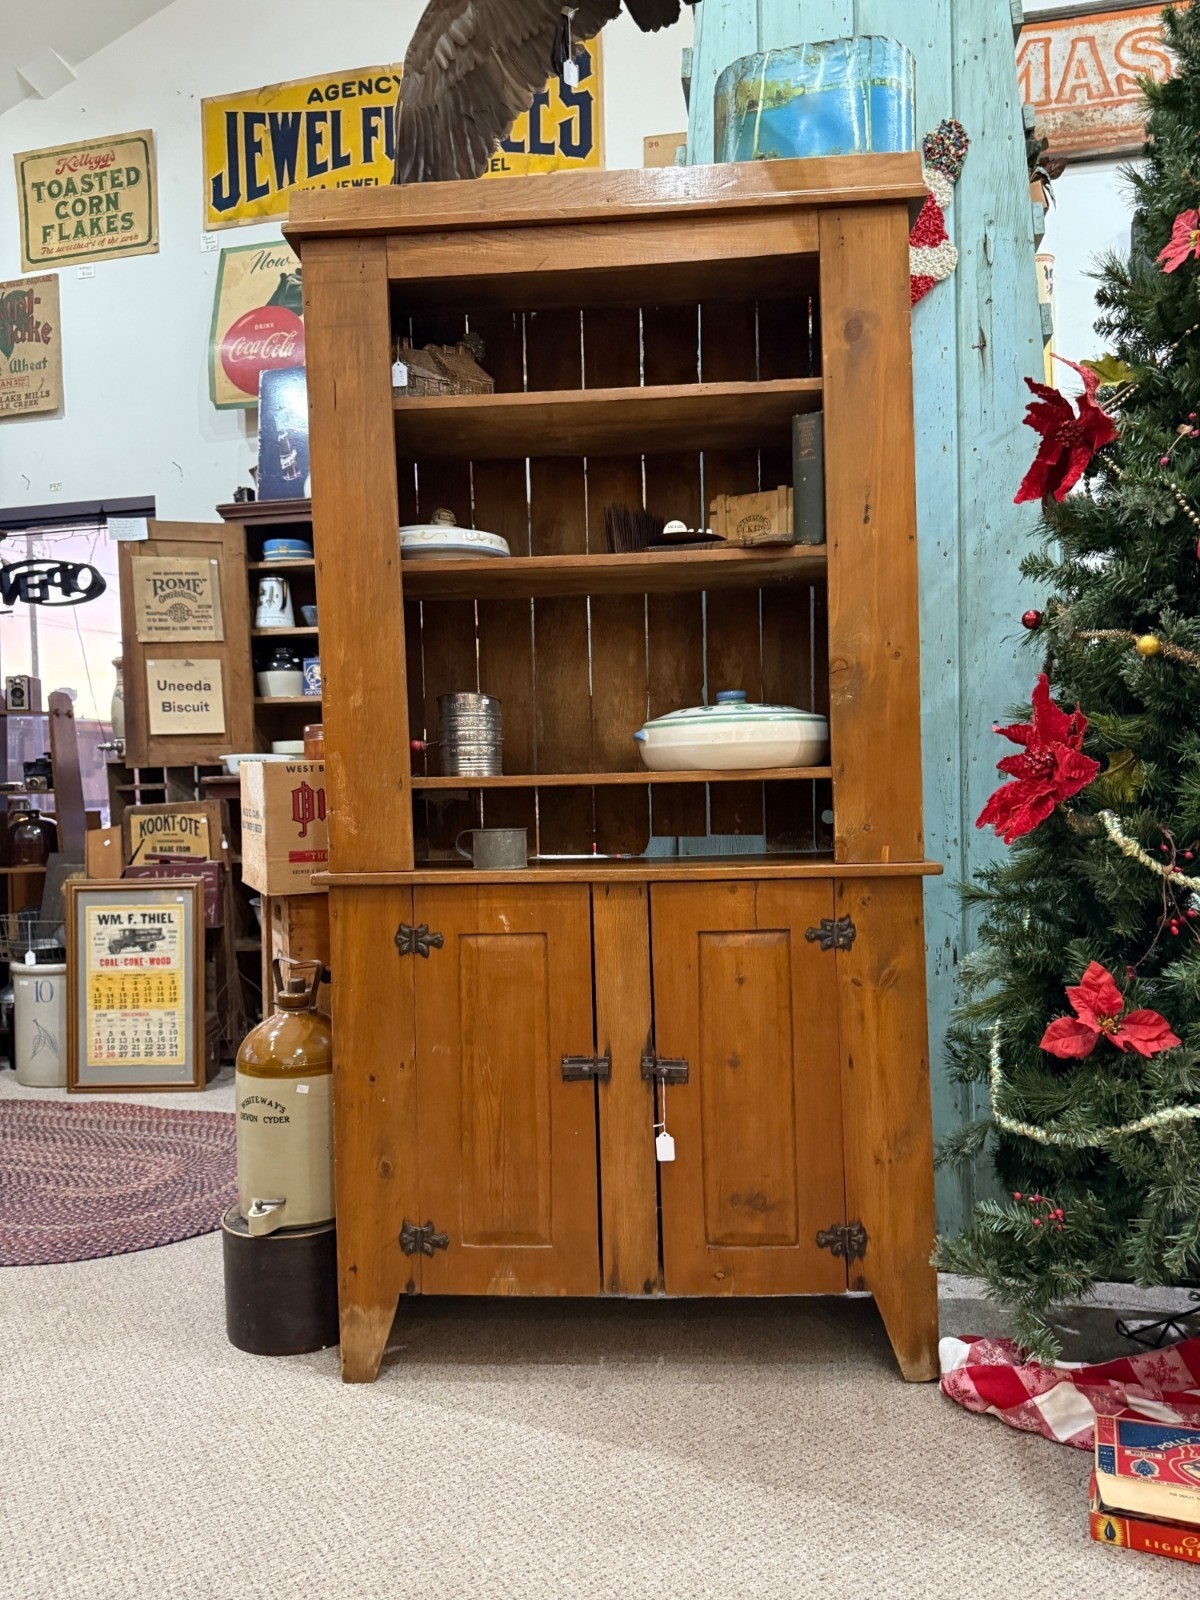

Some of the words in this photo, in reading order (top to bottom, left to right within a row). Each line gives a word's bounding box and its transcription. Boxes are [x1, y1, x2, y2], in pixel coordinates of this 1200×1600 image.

[211, 110, 351, 213] JEWEL
[31, 166, 142, 203] TOASTED
[55, 191, 121, 220] CORN
[42, 212, 135, 245] FLAKES
[255, 322, 274, 331] DRINK
[24, 390, 51, 401] MILLS
[13, 399, 39, 408] CREEK
[157, 680, 212, 691] Uneeda
[162, 701, 210, 713] Biscuit
[286, 764, 315, 773] WEST
[97, 914, 124, 926] WM.
[127, 913, 137, 925] F.
[140, 913, 174, 925] THIEL
[99, 958, 119, 967] COAL
[124, 957, 144, 967] COKE
[148, 956, 172, 966] WOOD
[34, 980, 54, 1003] 10
[241, 1096, 286, 1113] WHITEWAY'S
[240, 1112, 258, 1123] DEVON
[263, 1116, 290, 1124] CYDER
